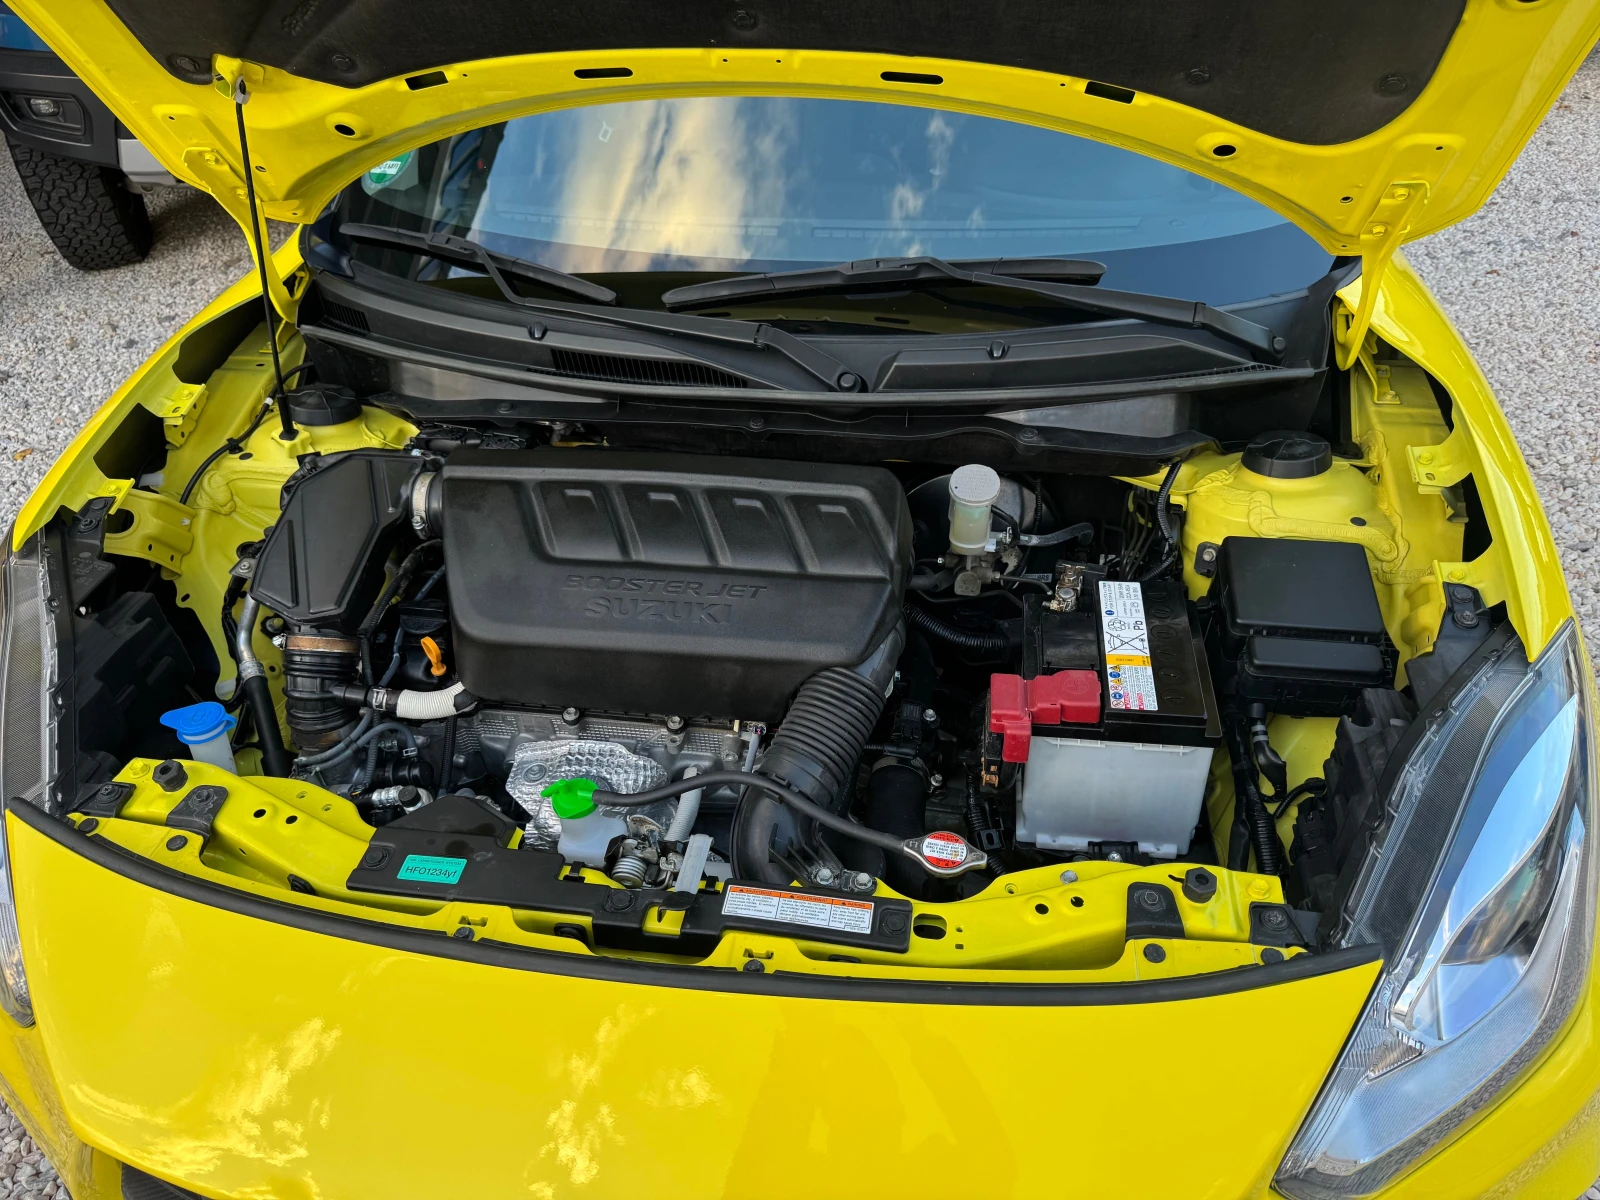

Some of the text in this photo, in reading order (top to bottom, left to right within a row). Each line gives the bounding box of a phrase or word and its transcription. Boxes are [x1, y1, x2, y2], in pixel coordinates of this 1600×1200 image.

[584, 596, 733, 624] SUZUKI
[1134, 620, 1144, 630] Pb
[405, 866, 458, 878] HFO1234yf
